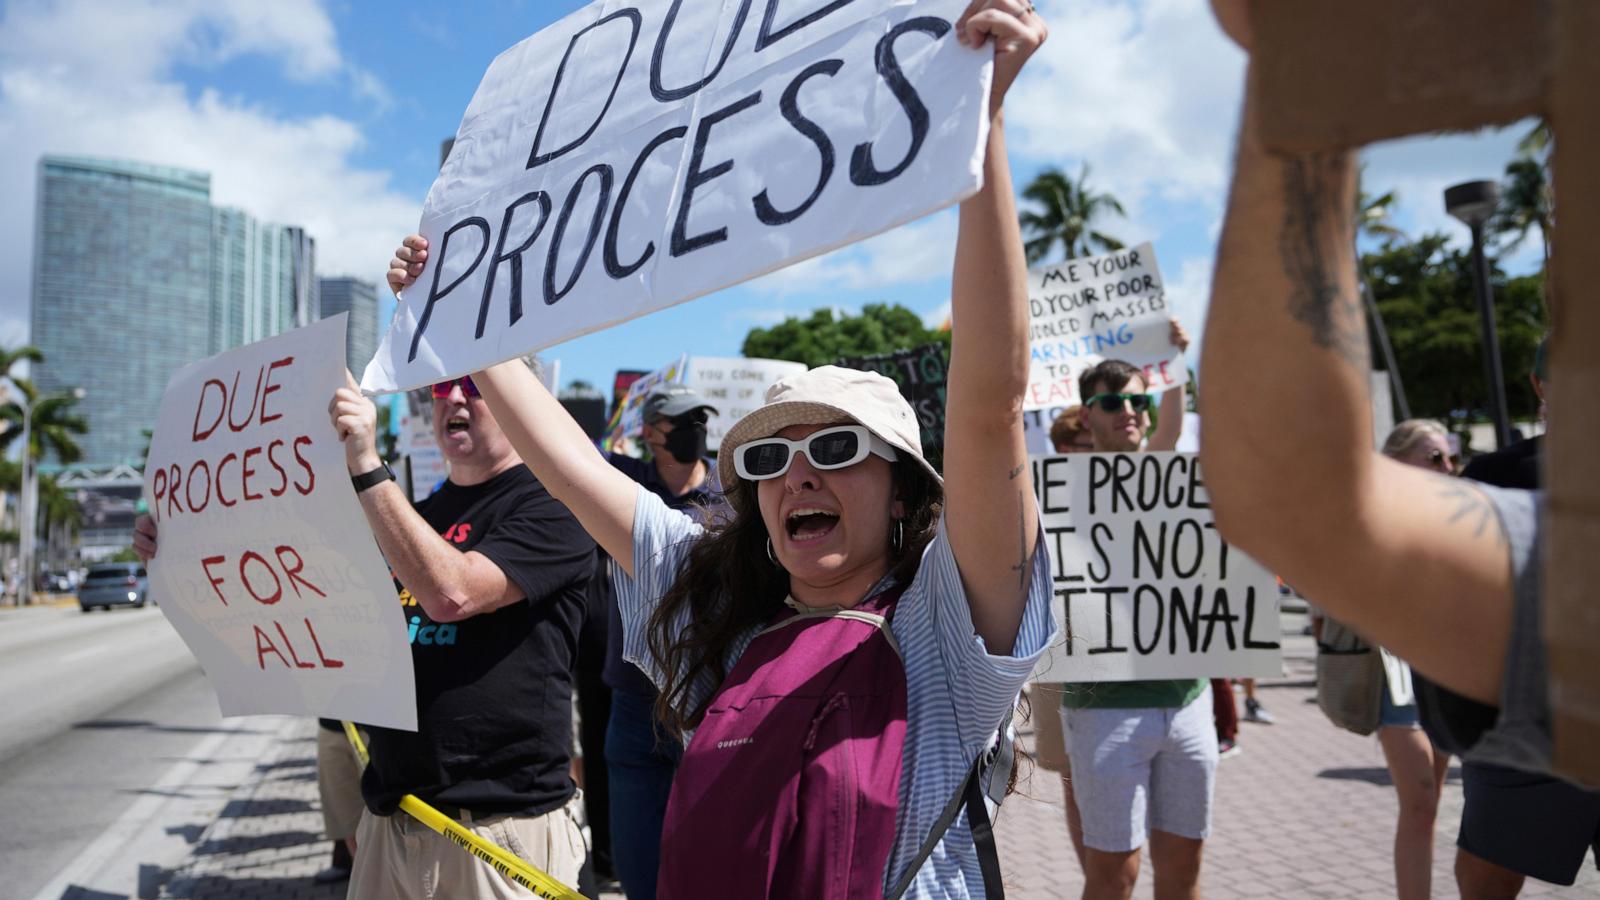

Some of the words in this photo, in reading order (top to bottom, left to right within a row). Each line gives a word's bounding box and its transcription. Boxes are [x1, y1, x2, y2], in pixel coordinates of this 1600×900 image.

[408, 16, 952, 363] PROCESS
[1041, 265, 1081, 288] ME
[1088, 251, 1142, 277] YOUR
[1044, 287, 1099, 315] YOUR
[1104, 275, 1159, 301] POOR
[1090, 291, 1166, 329] MASSES
[697, 368, 724, 380] YOU
[731, 368, 765, 381] COME
[1028, 377, 1074, 405] EAT
[1045, 363, 1071, 380] TO
[192, 356, 295, 442] DUE
[153, 435, 315, 522] PROCESS
[201, 545, 327, 607] FOR
[1046, 522, 1113, 583] IS
[1133, 518, 1229, 580] NOT
[253, 618, 344, 670] ALL
[1054, 584, 1281, 655] TIONAL
